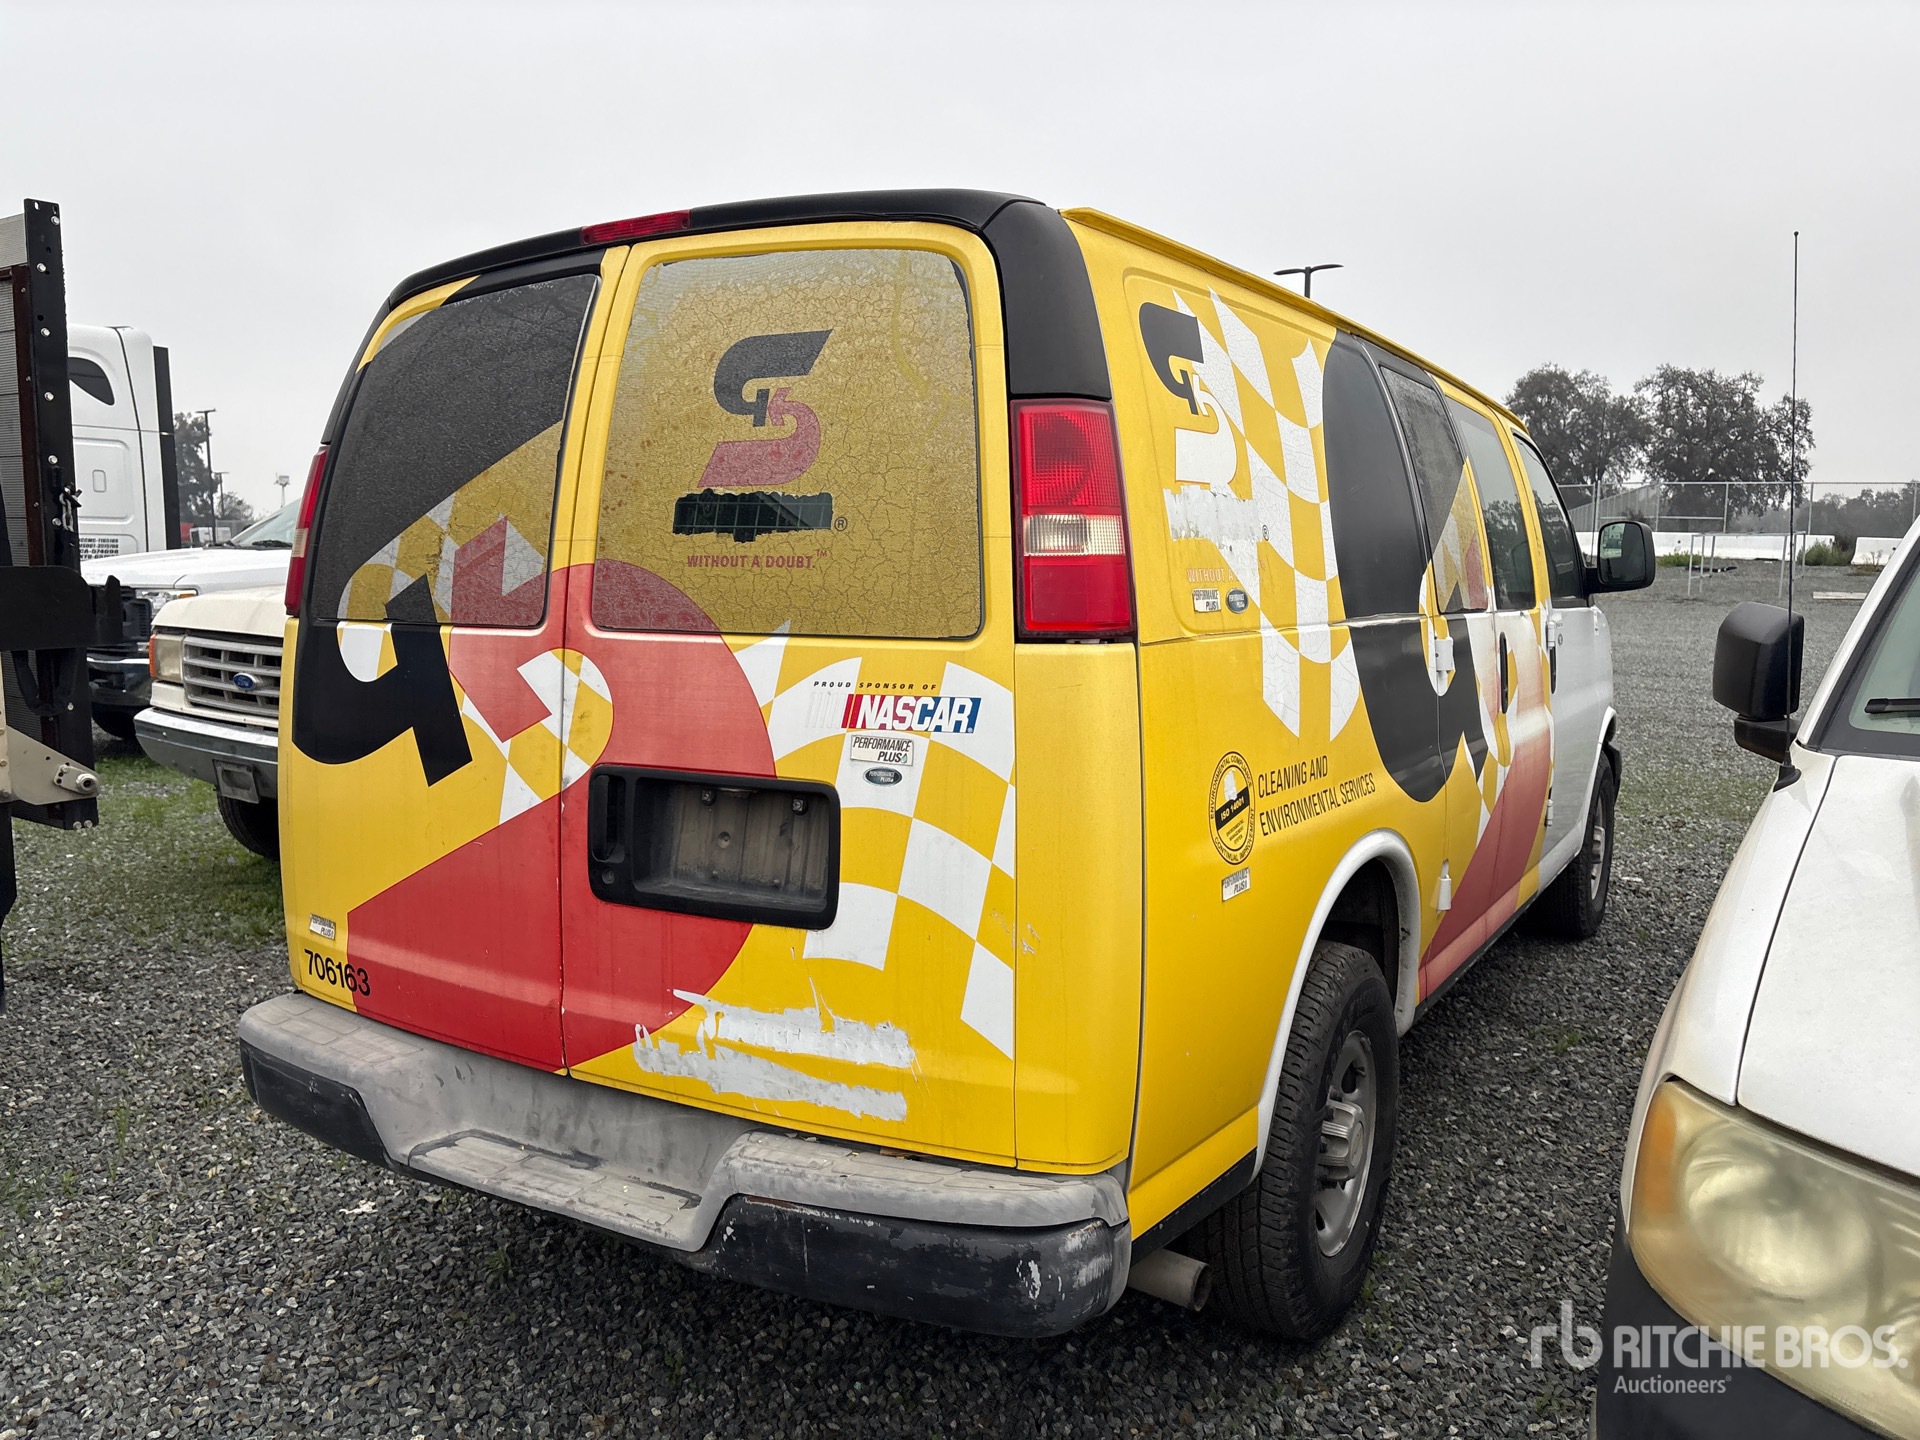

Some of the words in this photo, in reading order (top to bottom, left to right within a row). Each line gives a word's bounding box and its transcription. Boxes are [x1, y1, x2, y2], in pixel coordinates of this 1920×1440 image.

[687, 555, 748, 568] WITHOUT
[751, 555, 760, 568] A
[765, 555, 816, 569] DOUBT.
[1187, 568, 1225, 583] WITHOUT
[859, 682, 914, 690] SPONSOR
[922, 683, 937, 691] OF
[856, 694, 973, 733] NASCAR
[853, 736, 912, 752] PERFORMANCE
[877, 751, 903, 763] PLUS
[1258, 761, 1307, 798] CLEANING
[1309, 755, 1328, 782] AND
[1259, 786, 1341, 836] ENVIRONMENTAL
[1340, 772, 1376, 804] SERVICES
[1220, 808, 1230, 821] ISO
[304, 948, 371, 997] 706163
